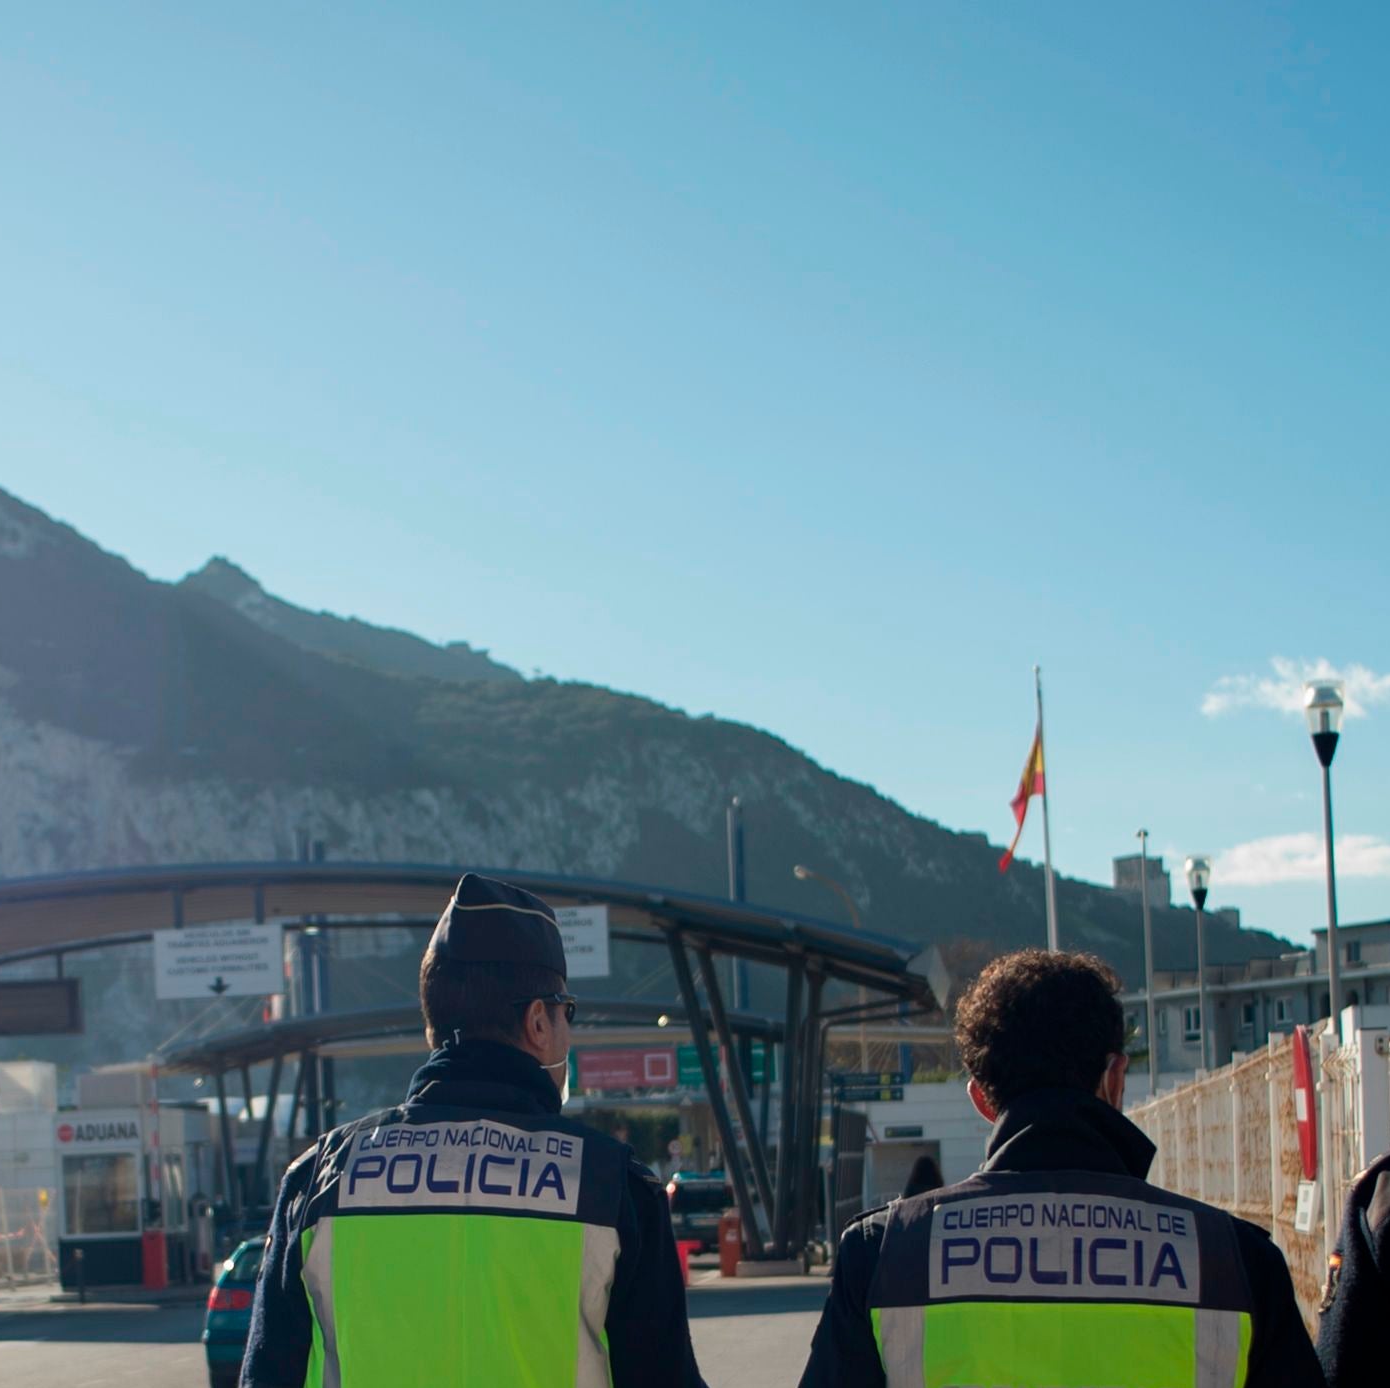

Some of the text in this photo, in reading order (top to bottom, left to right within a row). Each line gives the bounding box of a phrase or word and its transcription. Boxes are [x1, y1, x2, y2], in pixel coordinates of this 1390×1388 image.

[75, 1121, 139, 1141] ADUANA
[360, 1126, 573, 1158] CUERPO NACIONAL DE
[348, 1153, 566, 1201] POLICIA
[943, 1203, 1187, 1236] CUERPO NACIONAL DE
[941, 1236, 1188, 1290] POLICIA
